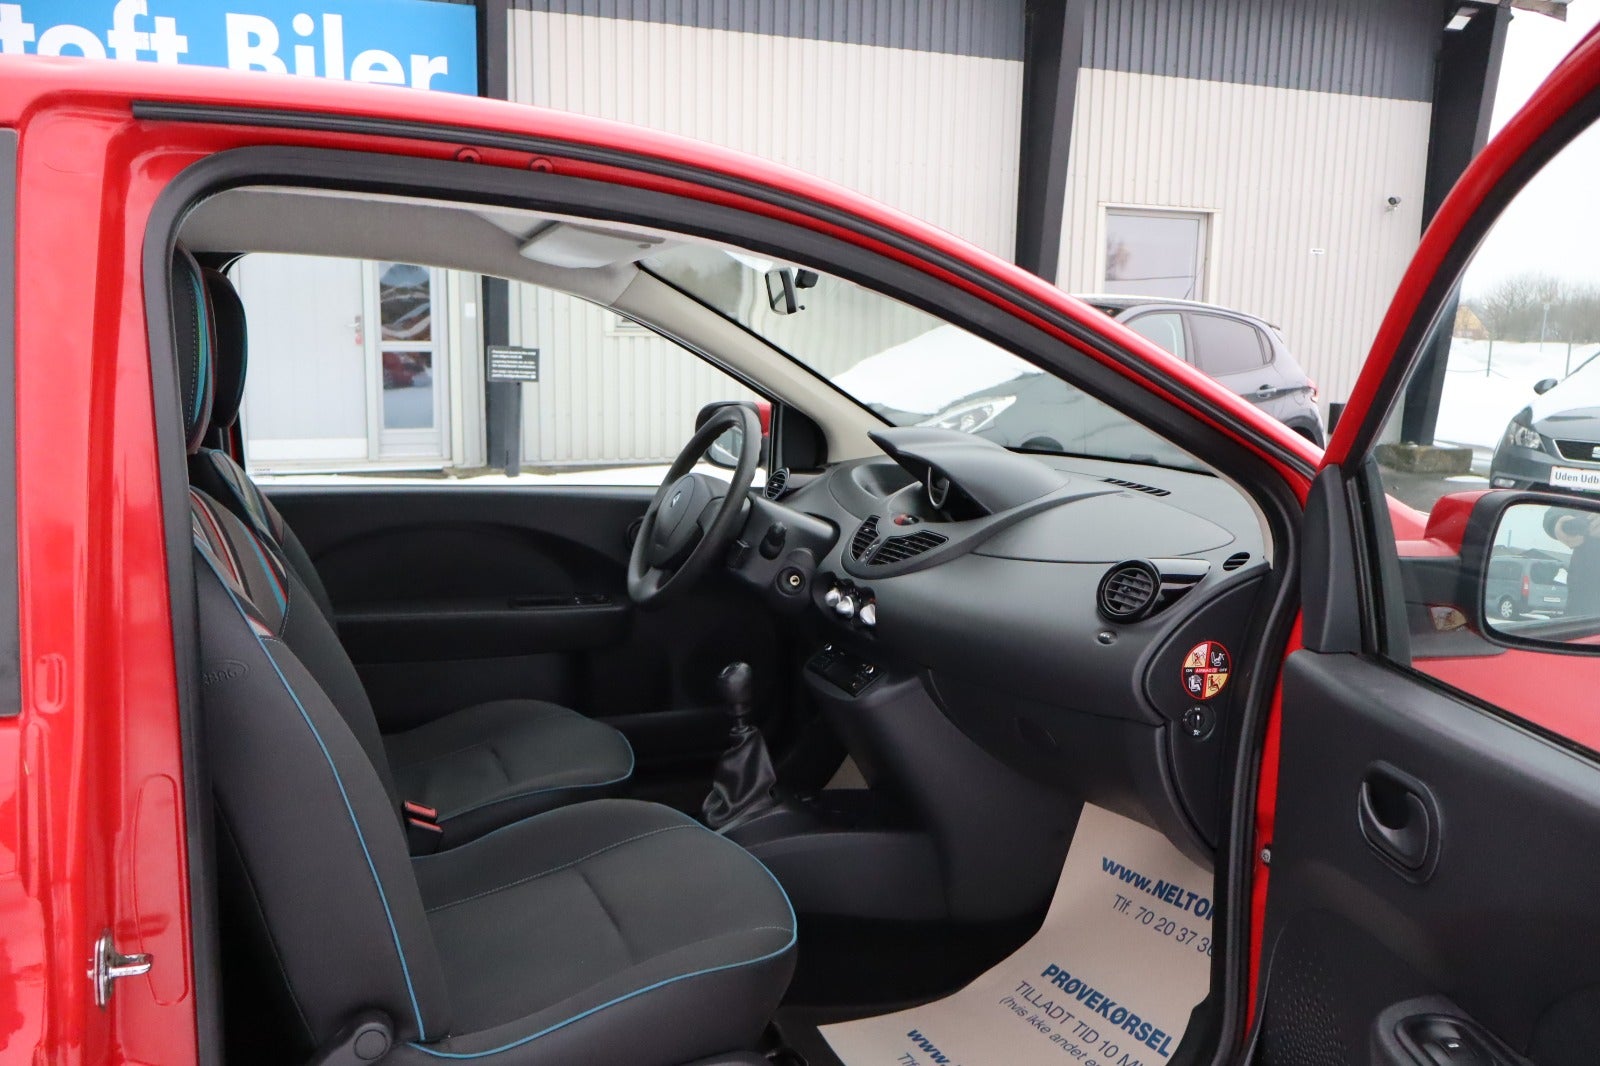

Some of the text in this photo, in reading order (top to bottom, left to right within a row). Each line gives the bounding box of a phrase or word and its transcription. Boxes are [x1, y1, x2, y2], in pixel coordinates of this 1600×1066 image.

[225, 13, 448, 91] Biler
[1555, 472, 1578, 482] Uden
[1112, 894, 1132, 915] Tlf.
[1134, 906, 1155, 925] 70
[1154, 917, 1176, 936] 20
[1176, 927, 1198, 945] 37
[1016, 980, 1075, 1024] TILLADT
[1072, 1020, 1099, 1044] TID
[1098, 1040, 1119, 1058] 10
[1026, 1014, 1051, 1033] ikke
[1049, 1033, 1088, 1060] andet
[1041, 963, 1172, 1058] PRØVEKØRSEL
